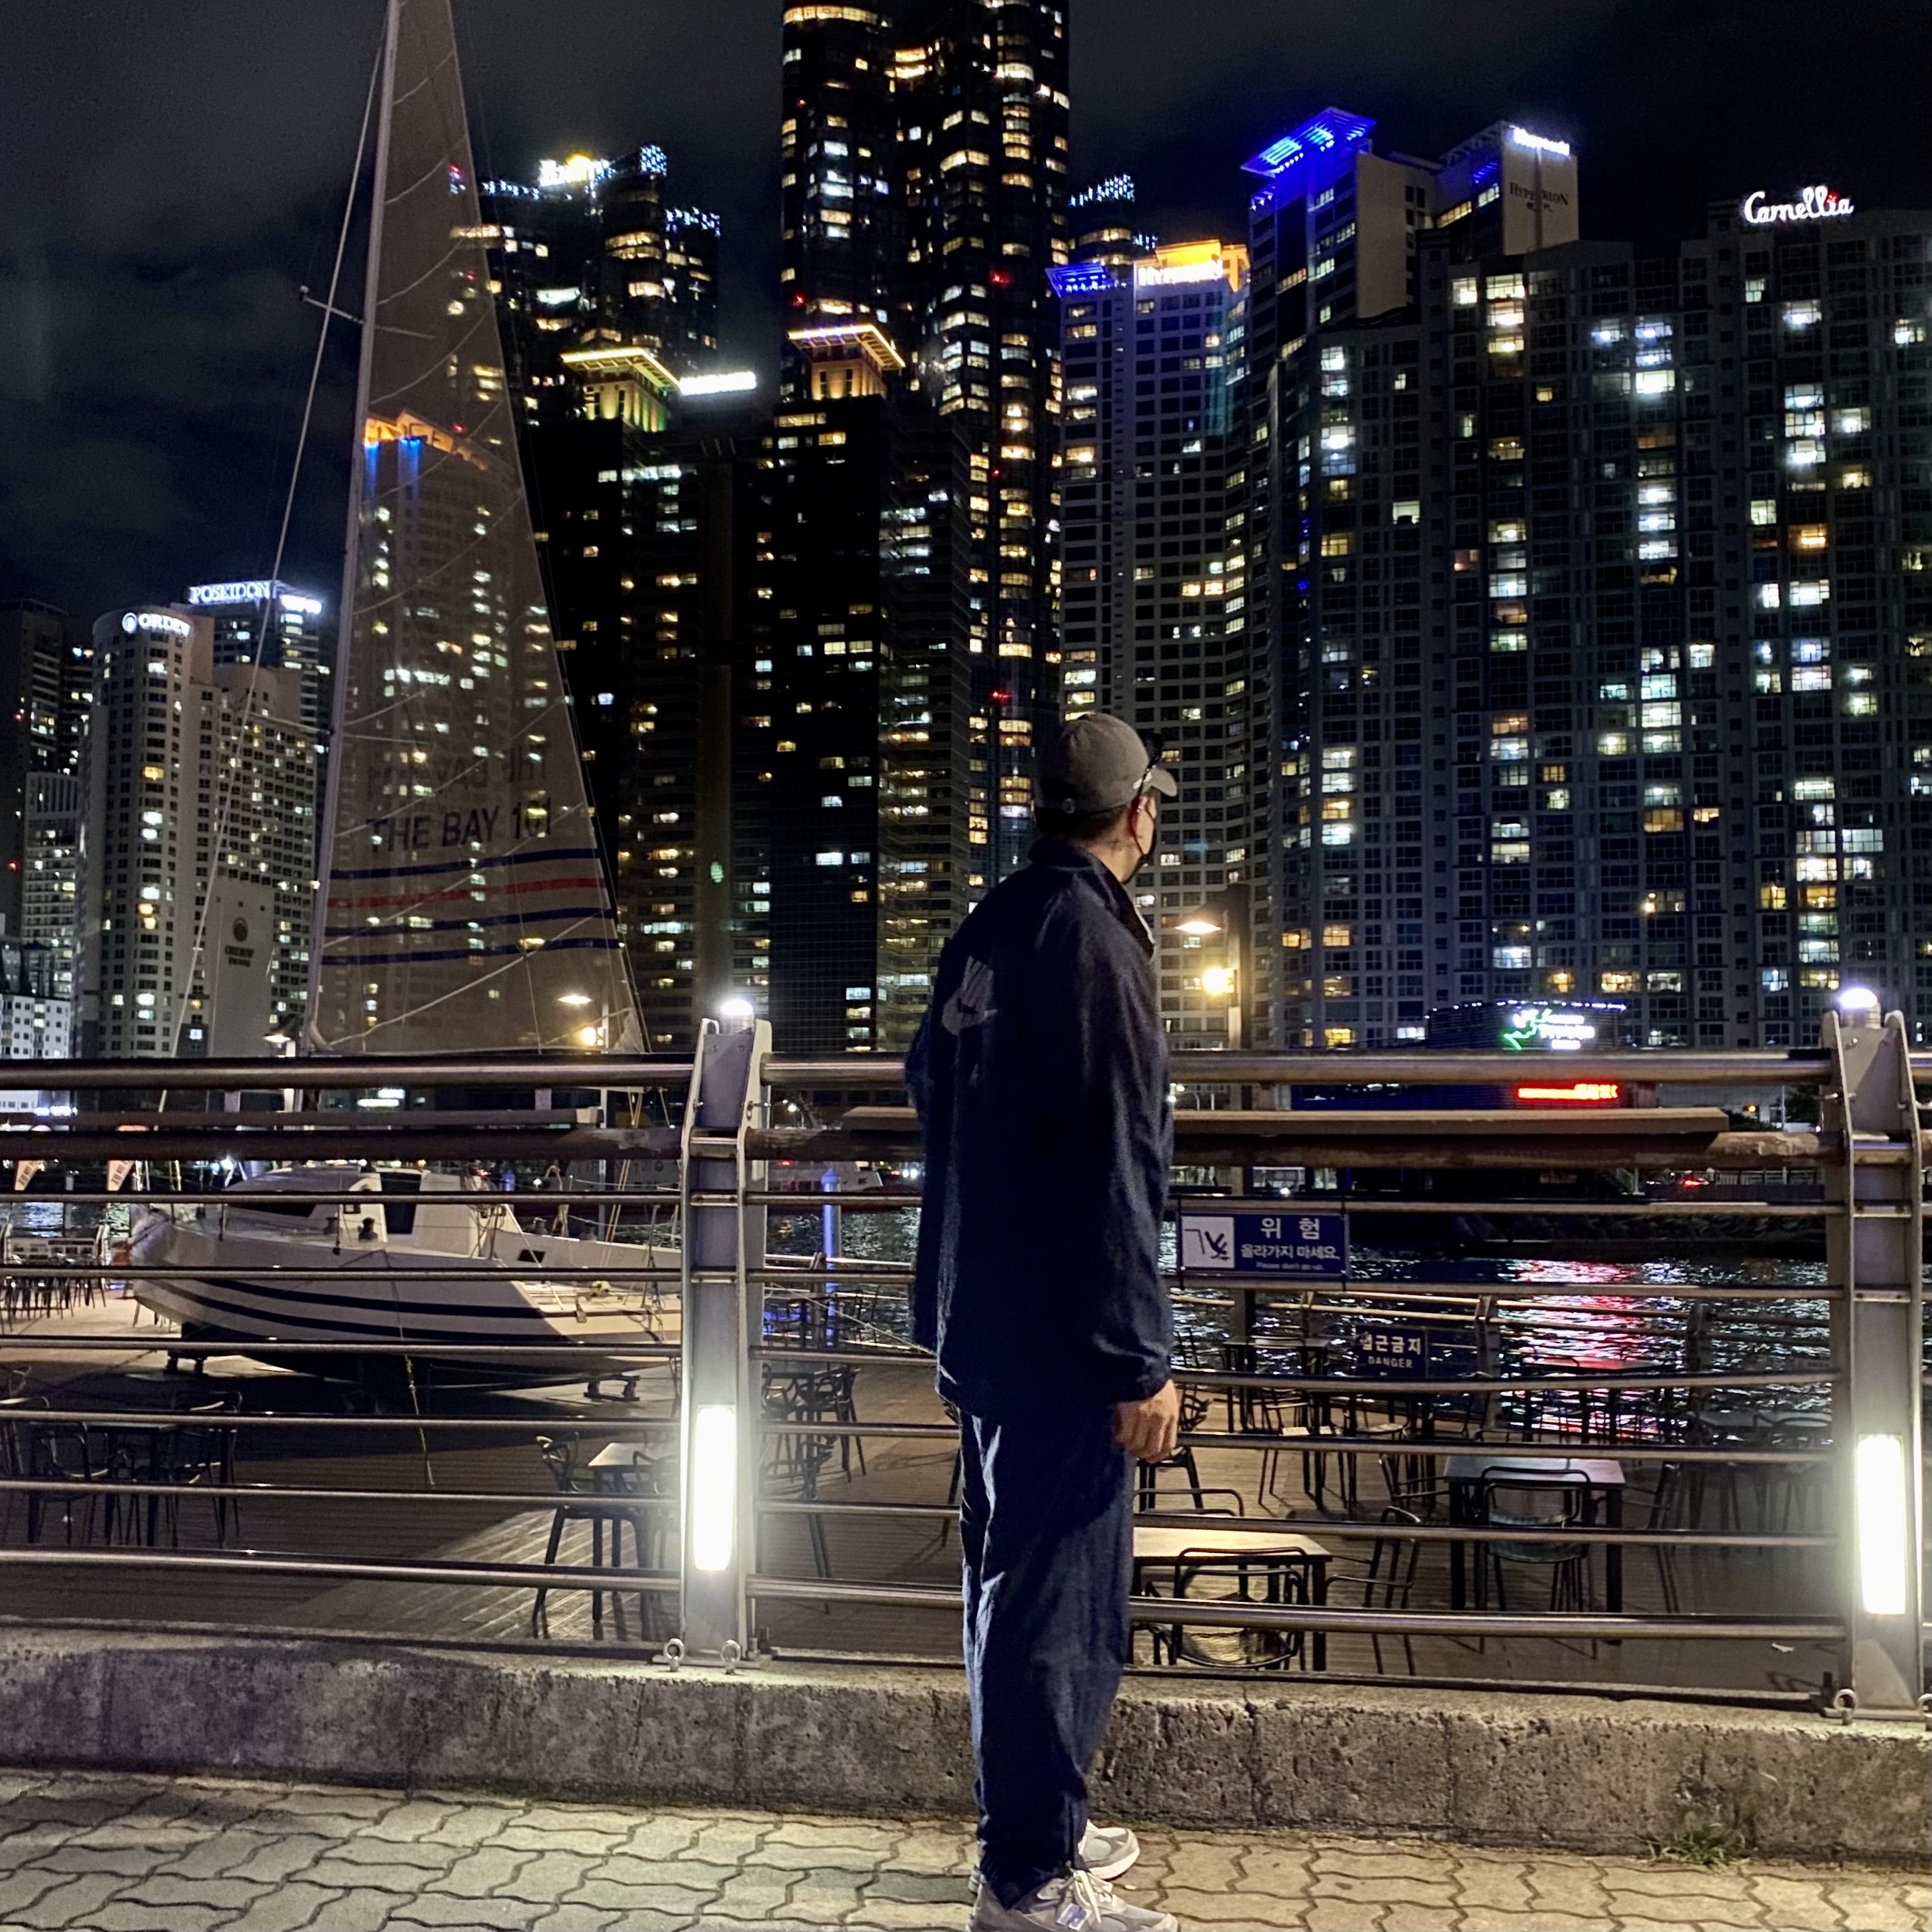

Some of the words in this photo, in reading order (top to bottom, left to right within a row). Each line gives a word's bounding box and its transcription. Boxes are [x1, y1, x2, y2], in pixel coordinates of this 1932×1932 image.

[1744, 184, 1855, 224] Camellia
[189, 581, 270, 604] POSEIDON
[365, 814, 431, 852] THE
[442, 805, 501, 847] BAY
[1368, 1355, 1413, 1369] DANGER
